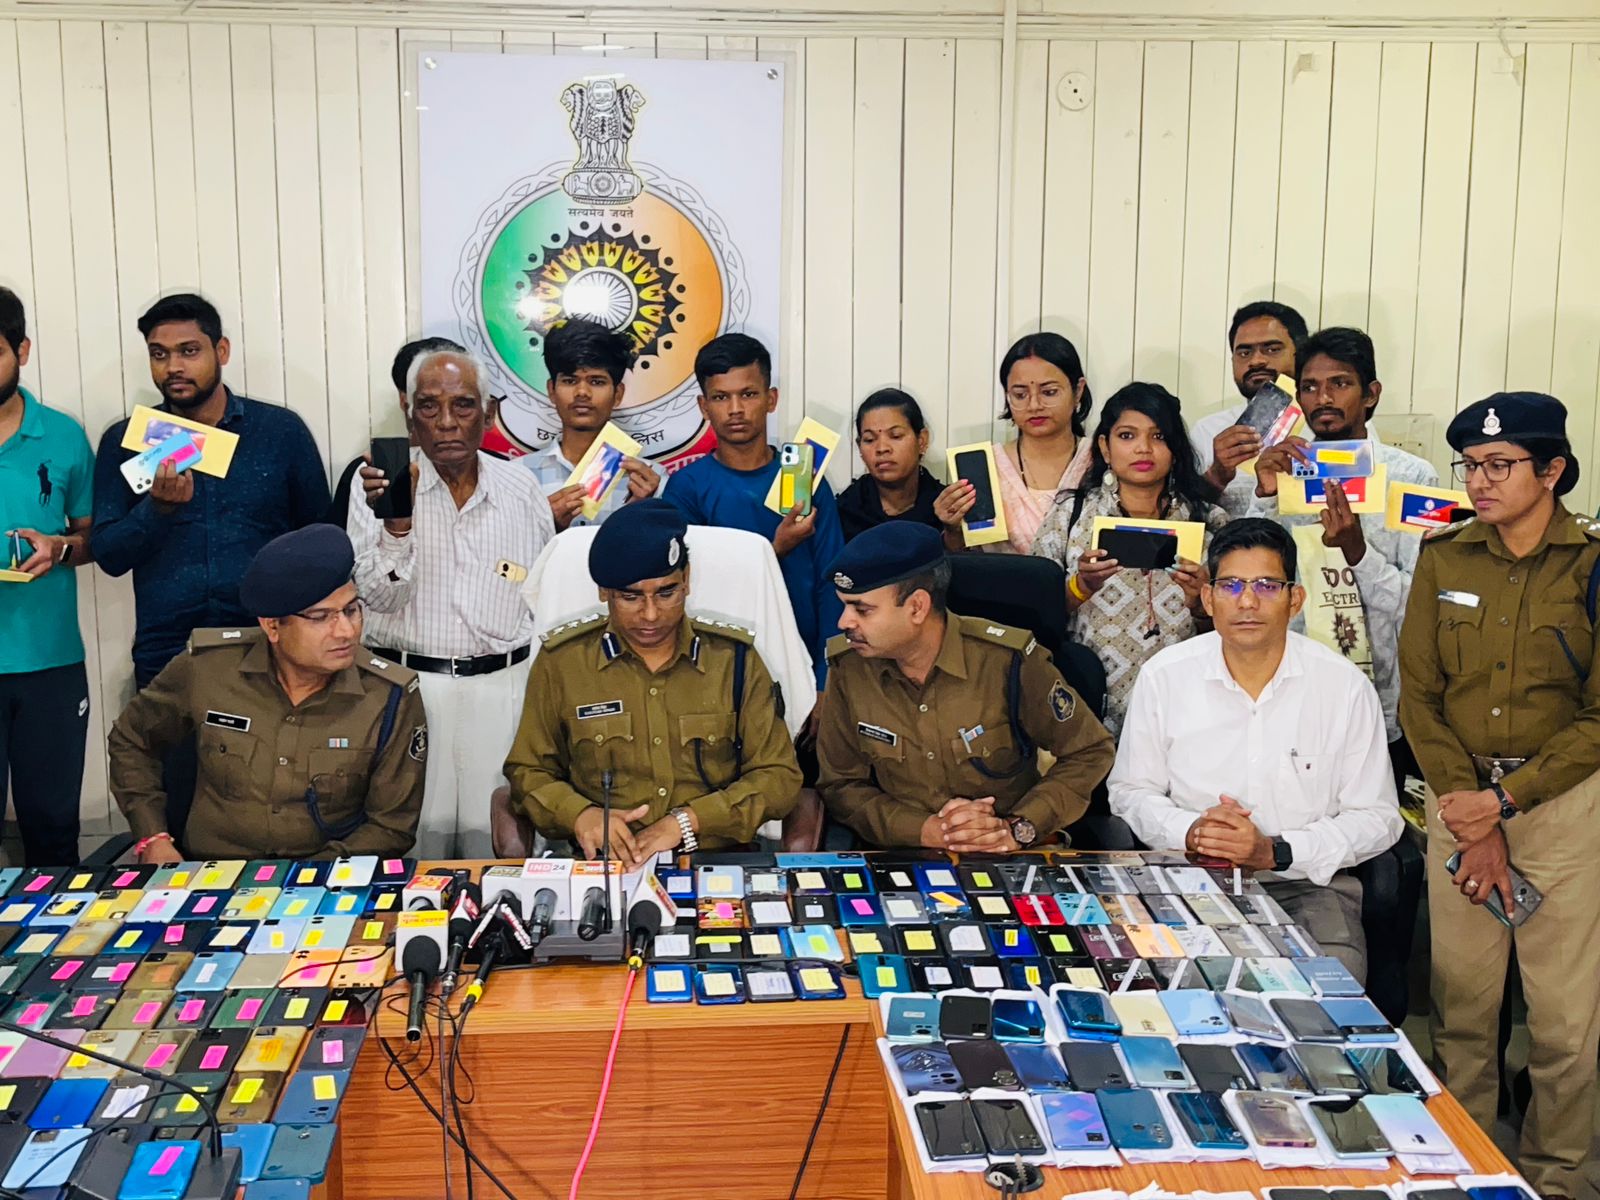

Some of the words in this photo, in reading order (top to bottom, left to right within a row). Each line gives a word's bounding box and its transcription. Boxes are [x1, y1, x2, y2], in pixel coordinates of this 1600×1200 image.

[568, 205, 605, 217] सत्यमेव
[609, 206, 634, 218] जयते
[552, 864, 567, 872] 24
